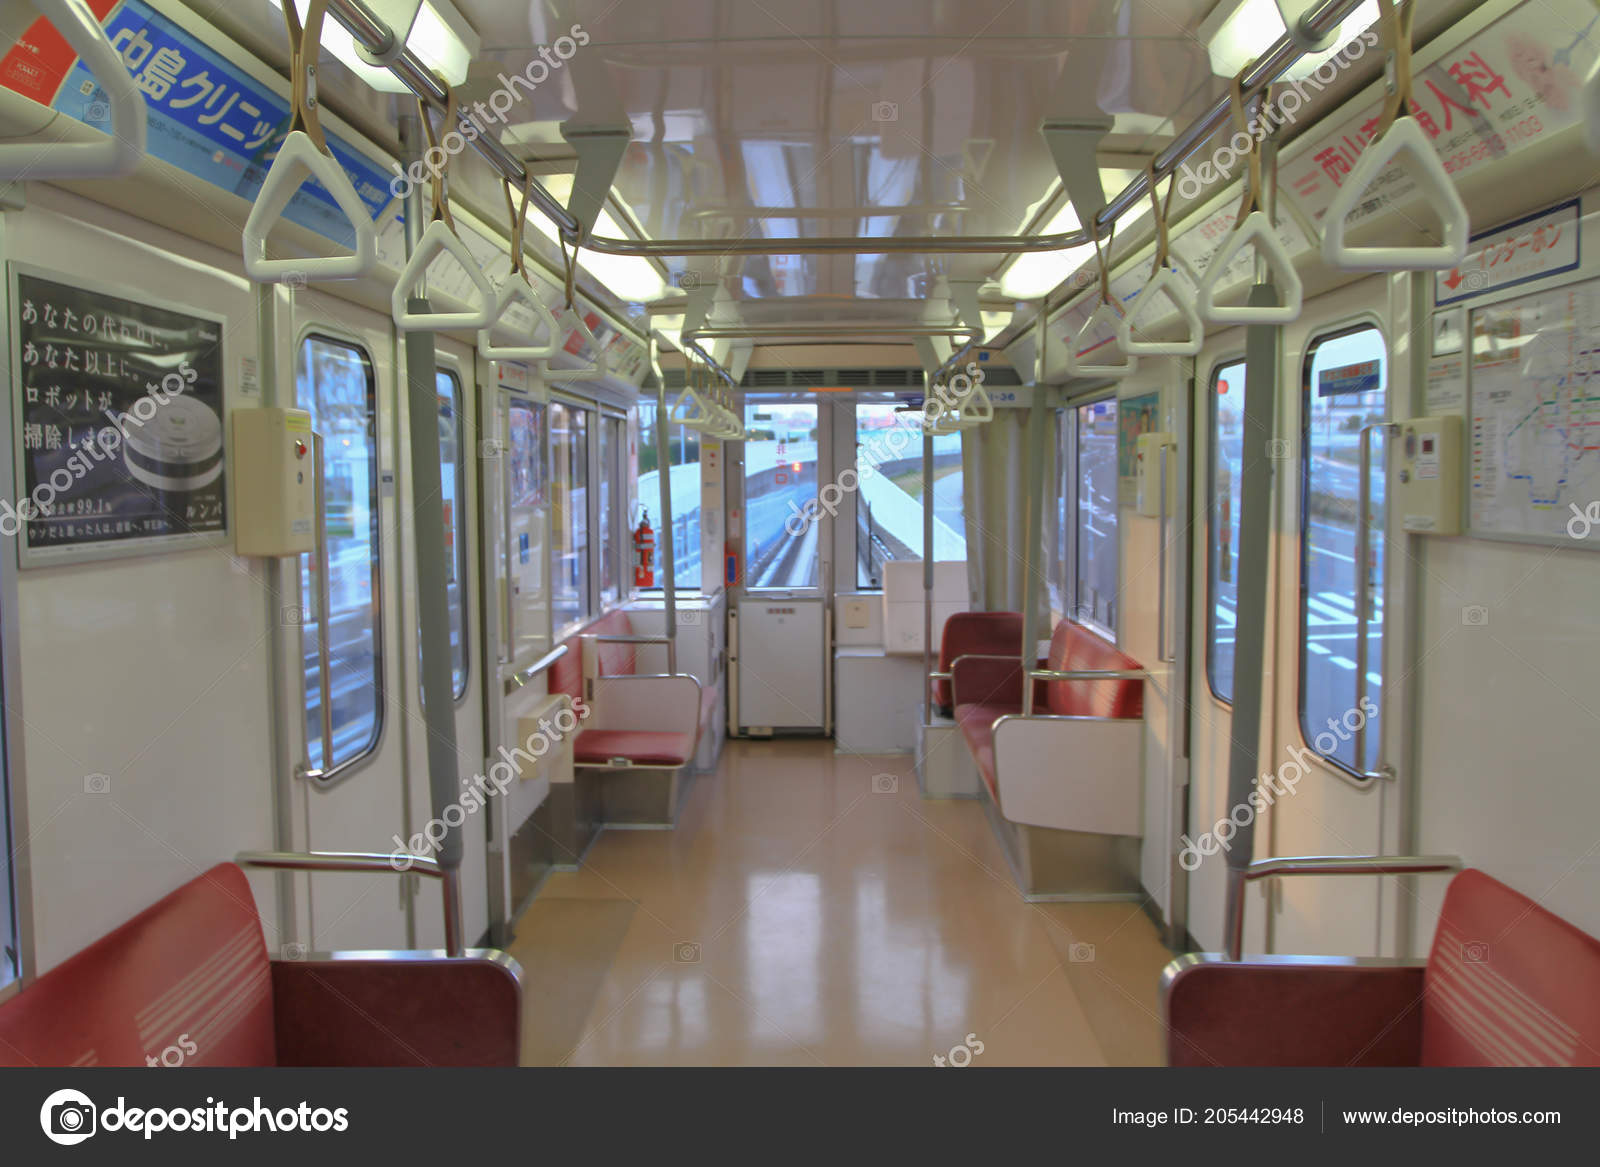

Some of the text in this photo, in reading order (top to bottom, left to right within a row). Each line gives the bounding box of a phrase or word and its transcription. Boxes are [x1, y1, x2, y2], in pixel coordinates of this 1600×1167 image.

[25, 385, 113, 412] ロボットが
